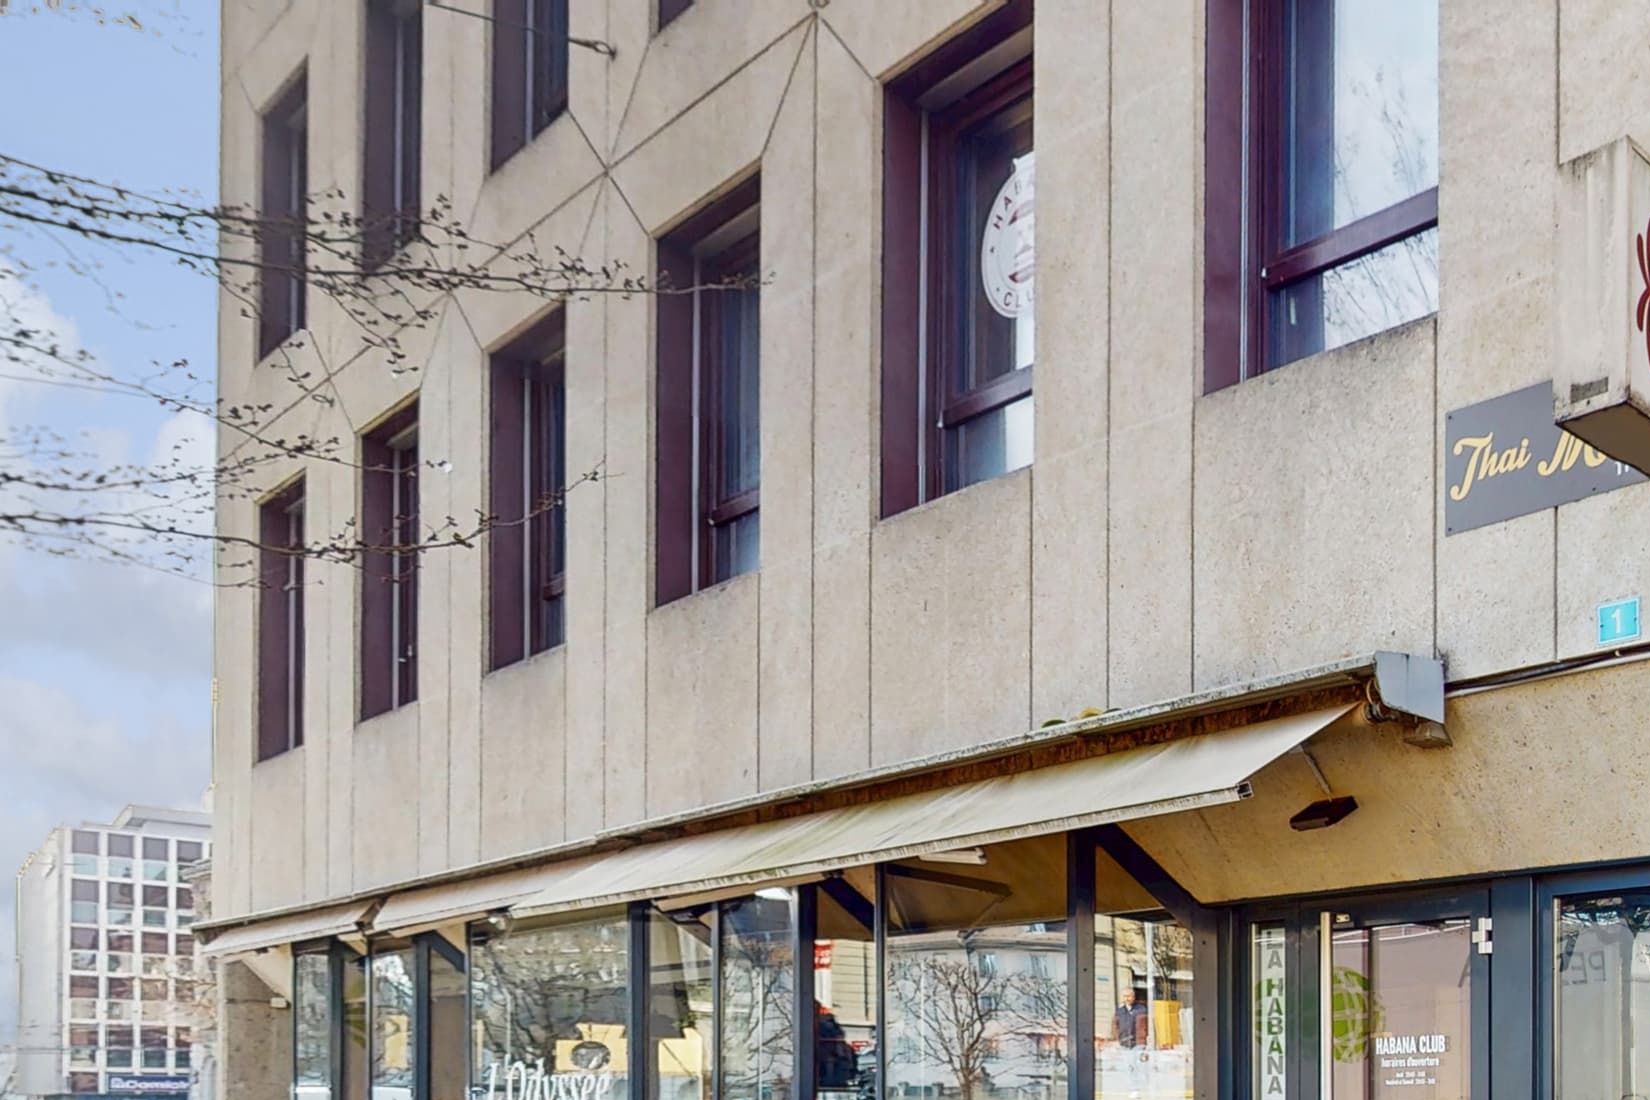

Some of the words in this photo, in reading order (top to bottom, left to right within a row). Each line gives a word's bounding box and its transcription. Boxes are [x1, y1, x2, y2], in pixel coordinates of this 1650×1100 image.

[1450, 431, 1532, 501] Thai
[1611, 608, 1621, 634] 1
[1266, 978, 1284, 1095] HABANA
[1375, 1035, 1417, 1055] HABANA
[1419, 1034, 1446, 1054] CLUB
